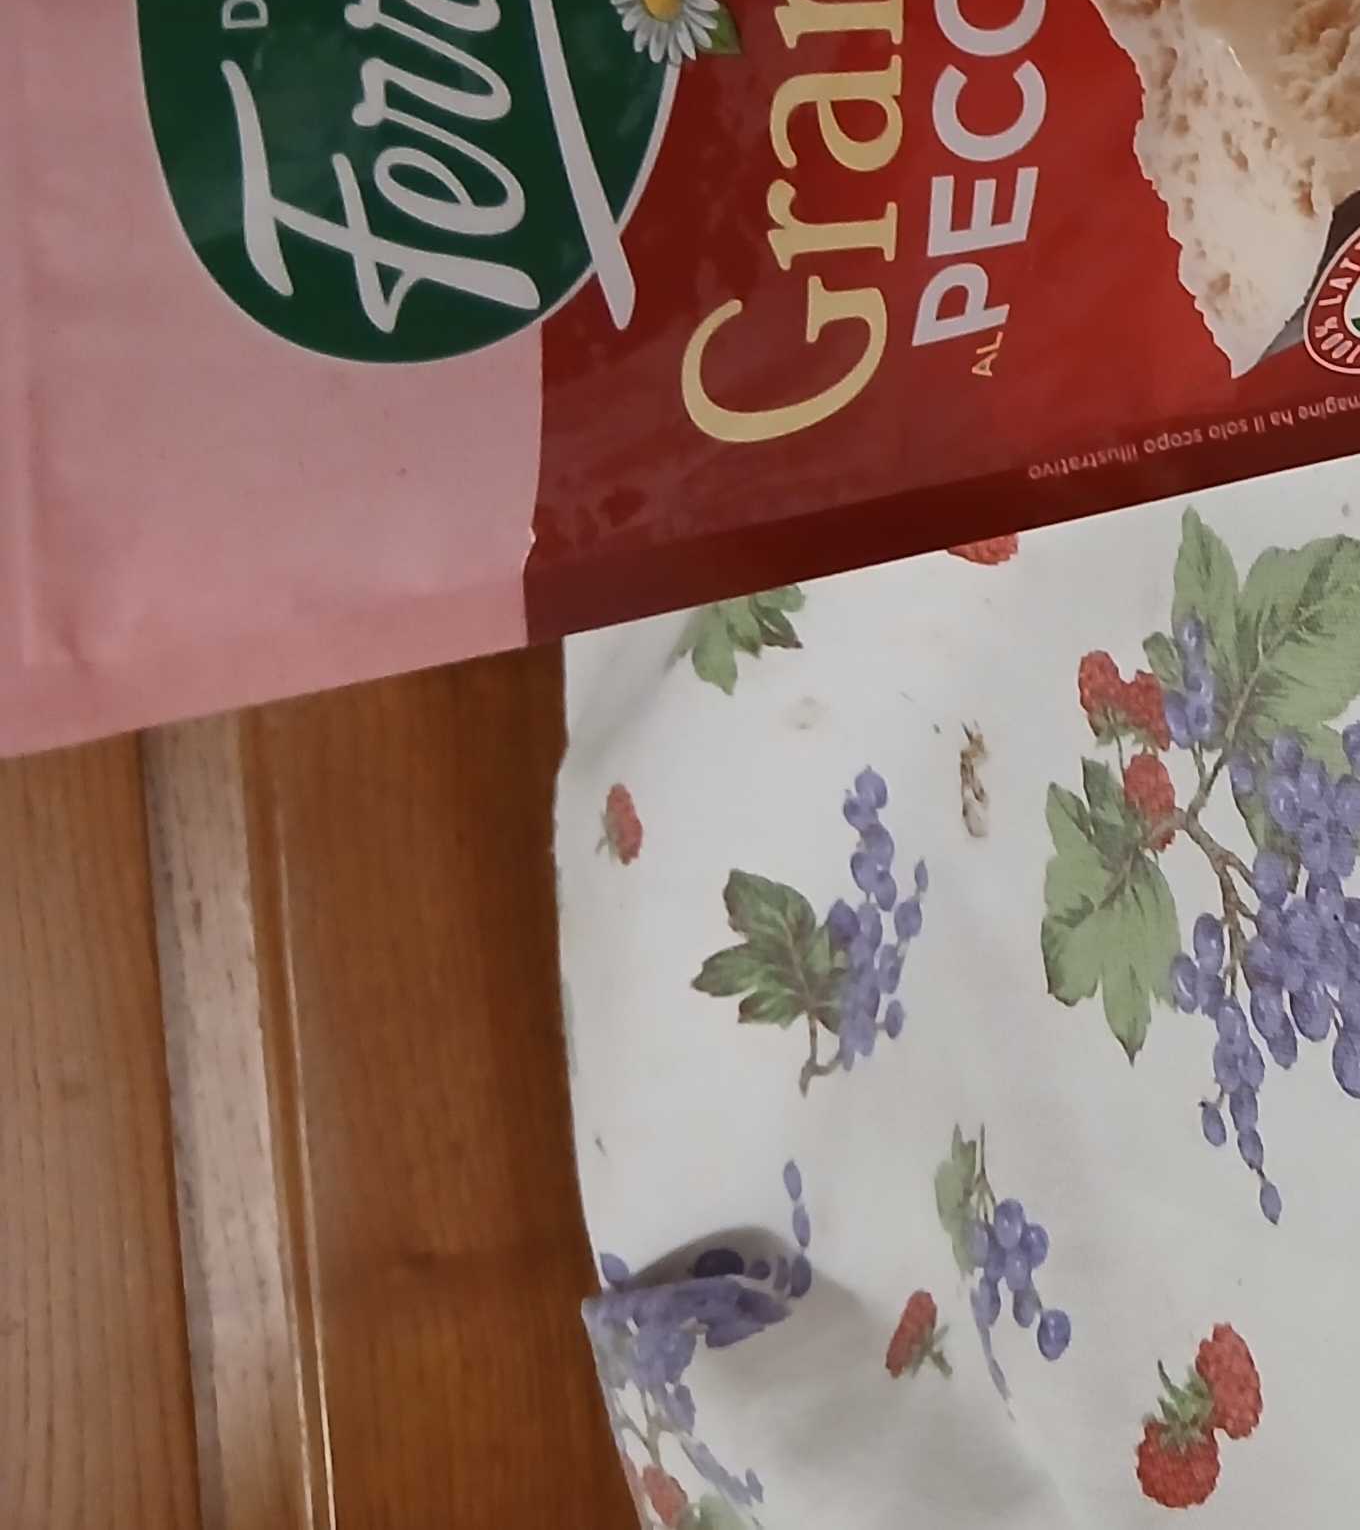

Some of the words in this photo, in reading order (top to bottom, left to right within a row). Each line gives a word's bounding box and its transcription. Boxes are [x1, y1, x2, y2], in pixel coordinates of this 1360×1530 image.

[971, 331, 1003, 376] AL
[1253, 416, 1266, 432] il
[1270, 409, 1293, 426] ha
[1208, 420, 1248, 439] solo
[1143, 429, 1202, 454] scopo
[1027, 442, 1137, 481] illustrativo
